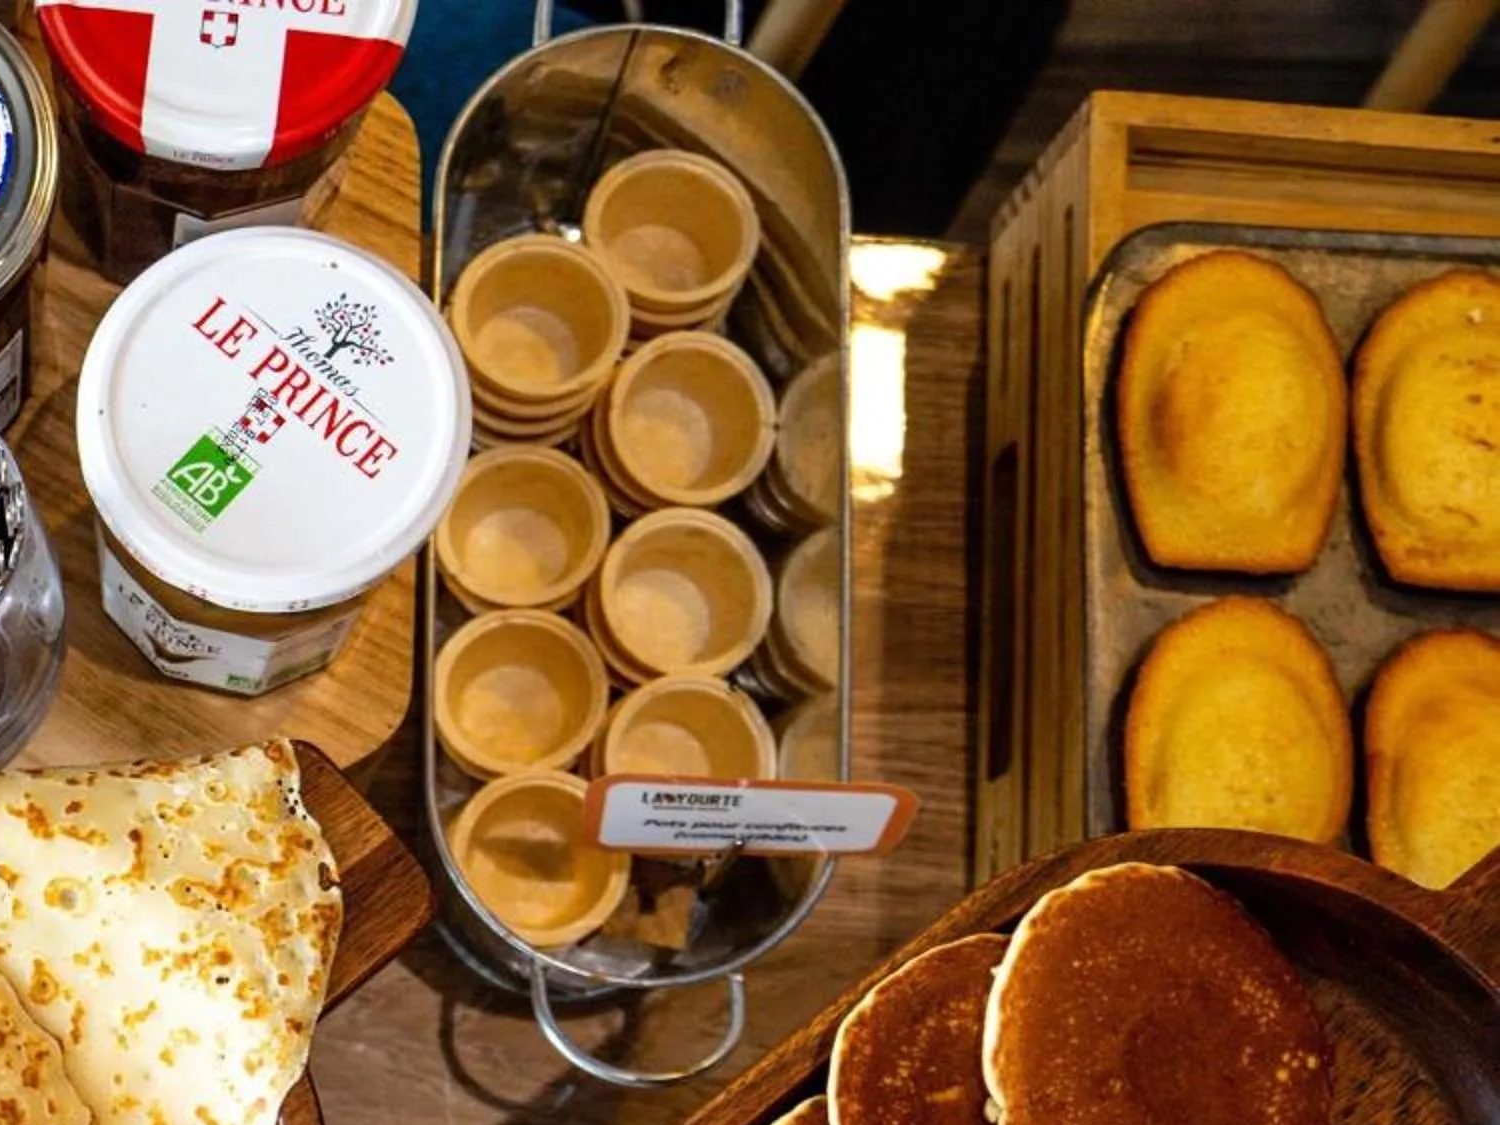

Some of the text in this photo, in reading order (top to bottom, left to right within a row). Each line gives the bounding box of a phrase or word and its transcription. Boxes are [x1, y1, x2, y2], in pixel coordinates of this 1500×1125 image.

[192, 296, 258, 359] LE
[248, 345, 398, 480] PRINCE
[279, 326, 359, 398] Thomas
